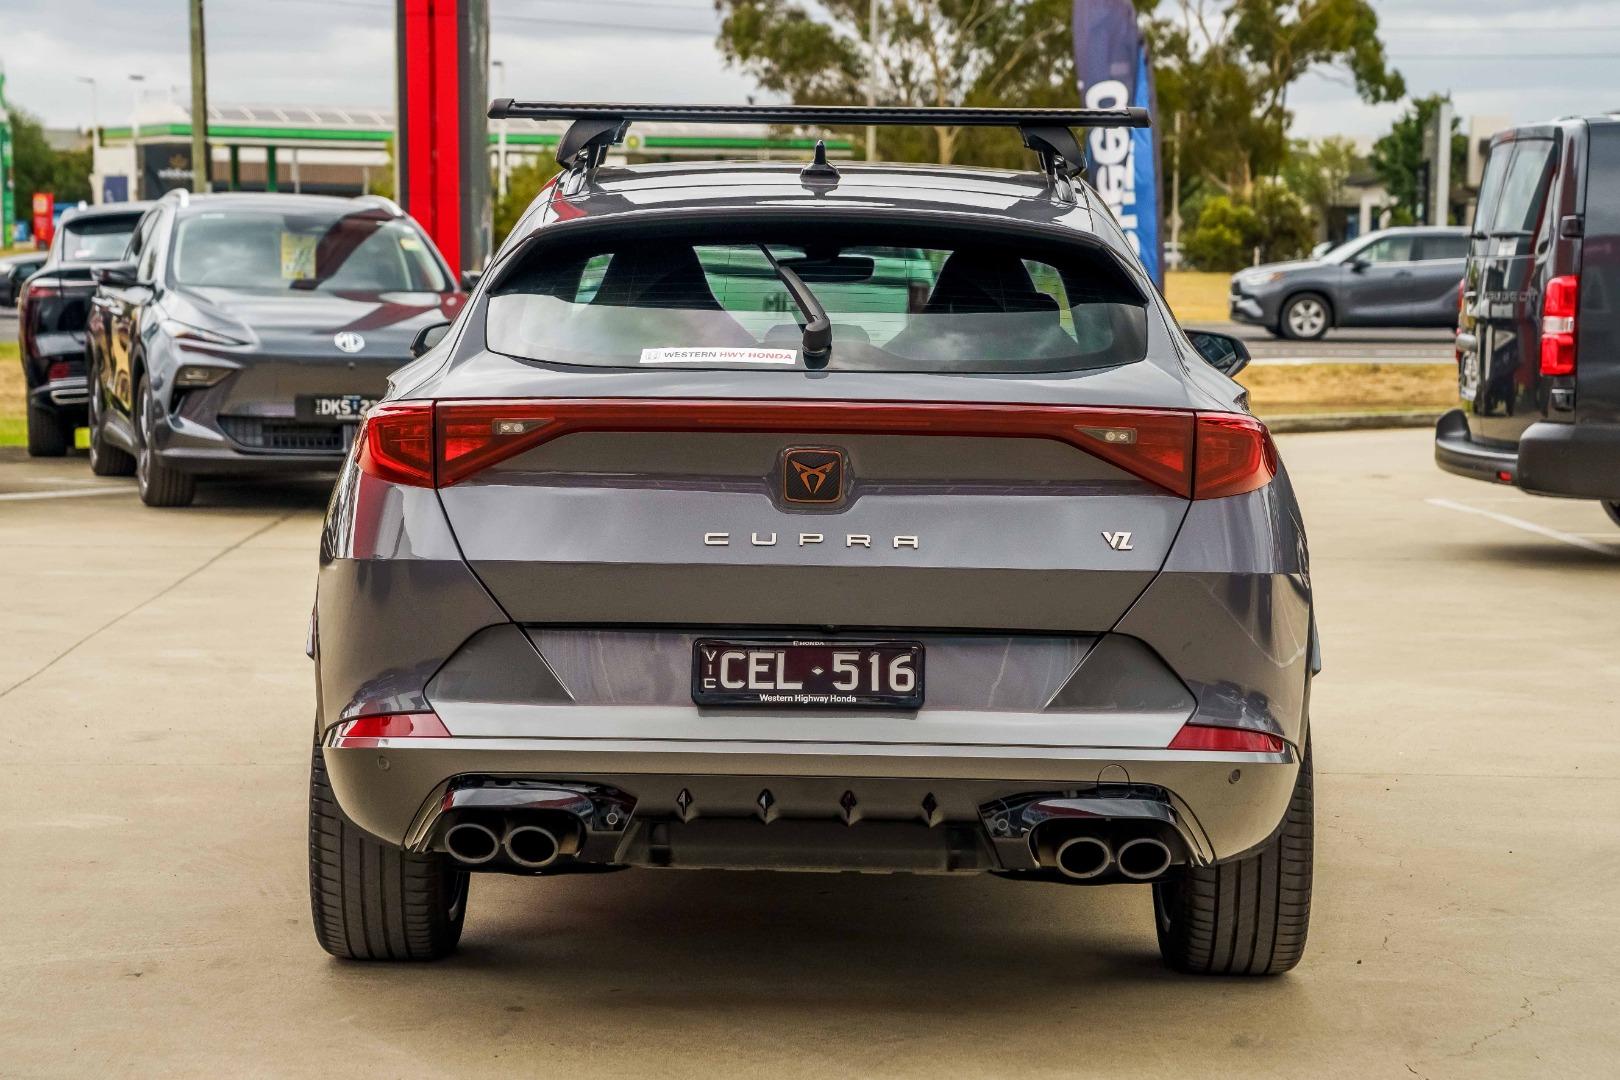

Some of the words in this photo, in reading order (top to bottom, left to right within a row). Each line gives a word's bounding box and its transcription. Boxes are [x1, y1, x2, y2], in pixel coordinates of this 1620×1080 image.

[748, 352, 793, 360] HONDA
[321, 399, 351, 415] DKS
[704, 532, 919, 549] CUPRA
[1101, 531, 1133, 550] VZ
[703, 651, 717, 689] VIC
[719, 651, 803, 690] CEL
[832, 651, 916, 692] 516
[759, 693, 793, 702] Western
[794, 694, 829, 704] Highway
[830, 694, 857, 703] Honda
